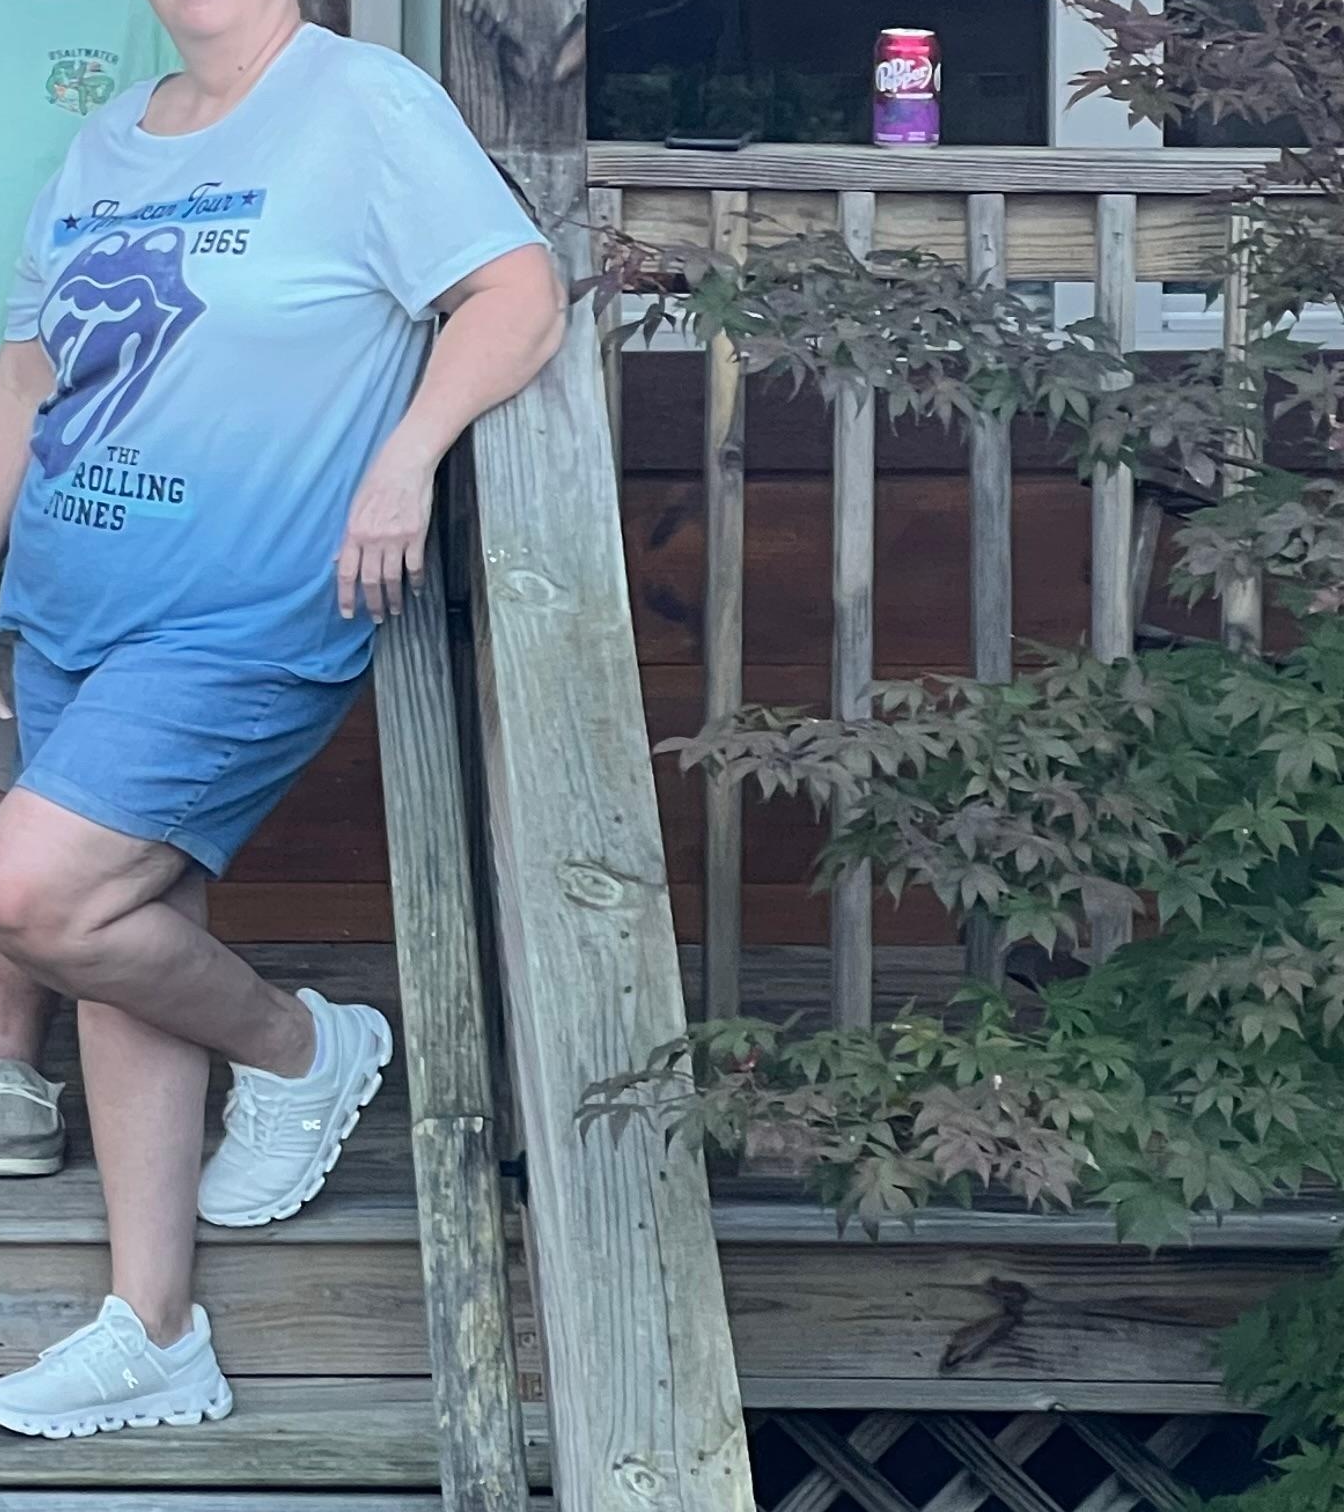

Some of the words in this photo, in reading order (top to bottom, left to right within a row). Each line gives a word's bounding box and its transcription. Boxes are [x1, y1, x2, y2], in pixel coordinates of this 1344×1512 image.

[878, 62, 928, 92] Pepper
[891, 58, 916, 74] Dr
[183, 182, 232, 218] Tour
[190, 229, 250, 255] 1965
[107, 446, 140, 466] THE
[72, 462, 186, 504] ROLLING
